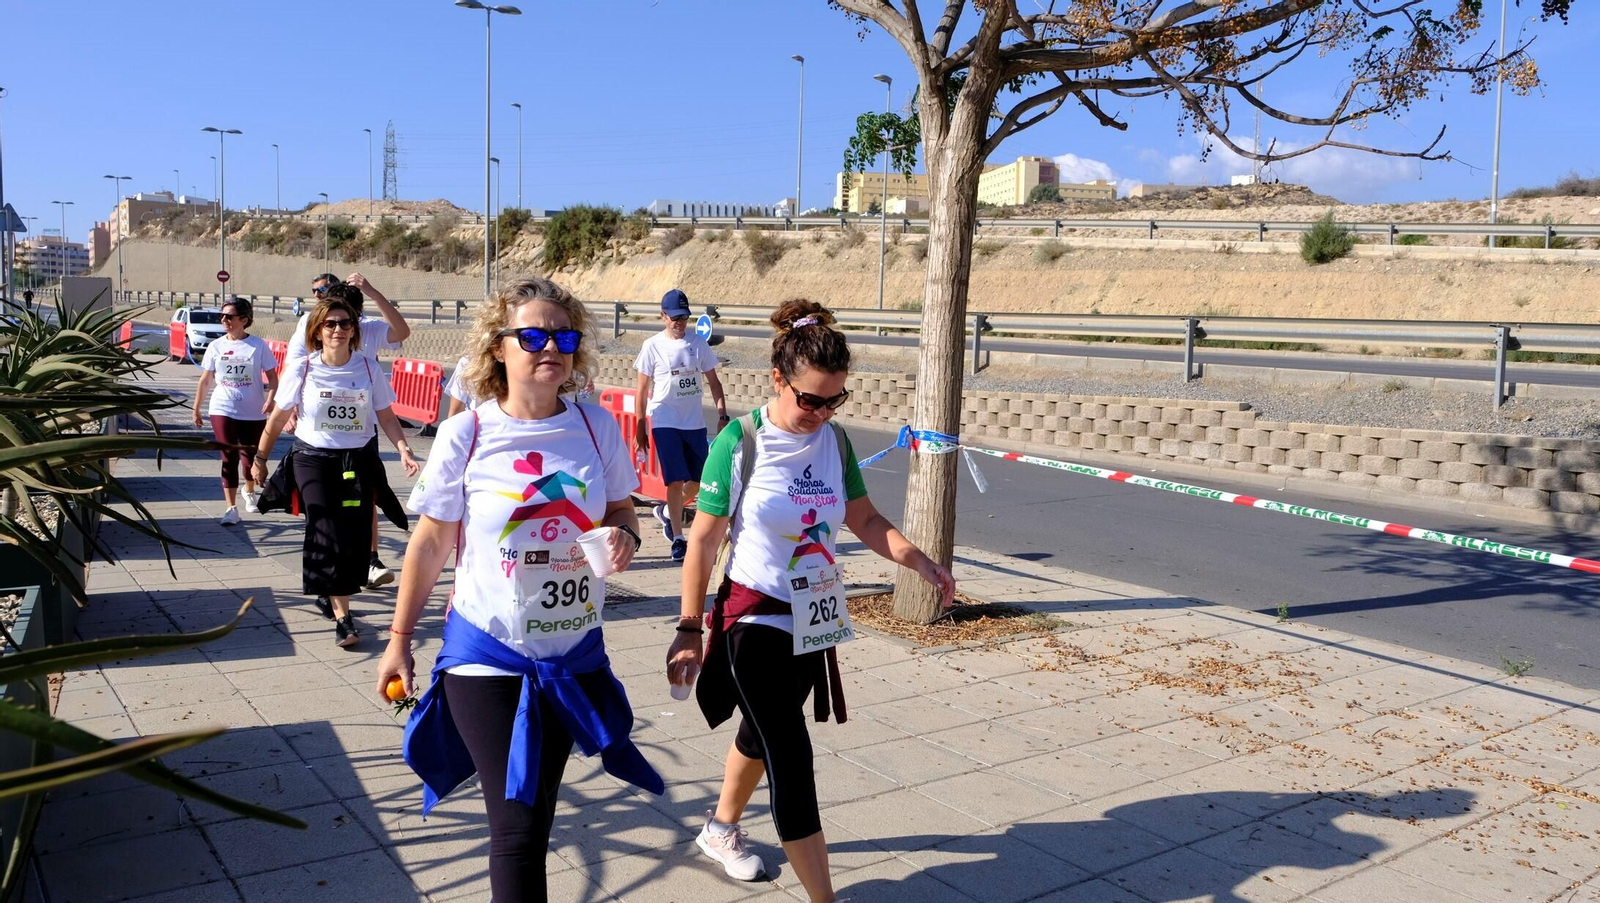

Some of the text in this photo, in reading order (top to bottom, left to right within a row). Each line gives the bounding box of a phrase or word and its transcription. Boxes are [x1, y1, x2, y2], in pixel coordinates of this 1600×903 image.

[226, 365, 246, 374] 217
[679, 377, 697, 388] 694
[328, 406, 357, 419] 633
[321, 422, 363, 431] Peregrin
[803, 464, 812, 480] 6
[794, 478, 825, 488] Horas
[1154, 481, 1223, 500] ALMESU
[788, 486, 834, 497] Solidarias
[791, 494, 838, 507] Non Stop
[1289, 505, 1370, 528] ALMESU
[541, 518, 561, 542] 6
[1452, 535, 1551, 563] ALMESU
[550, 563, 571, 572] Non
[541, 576, 589, 610] 396
[808, 595, 839, 626] 262
[526, 610, 597, 634] Peregrin
[802, 626, 851, 649] Peregrin
